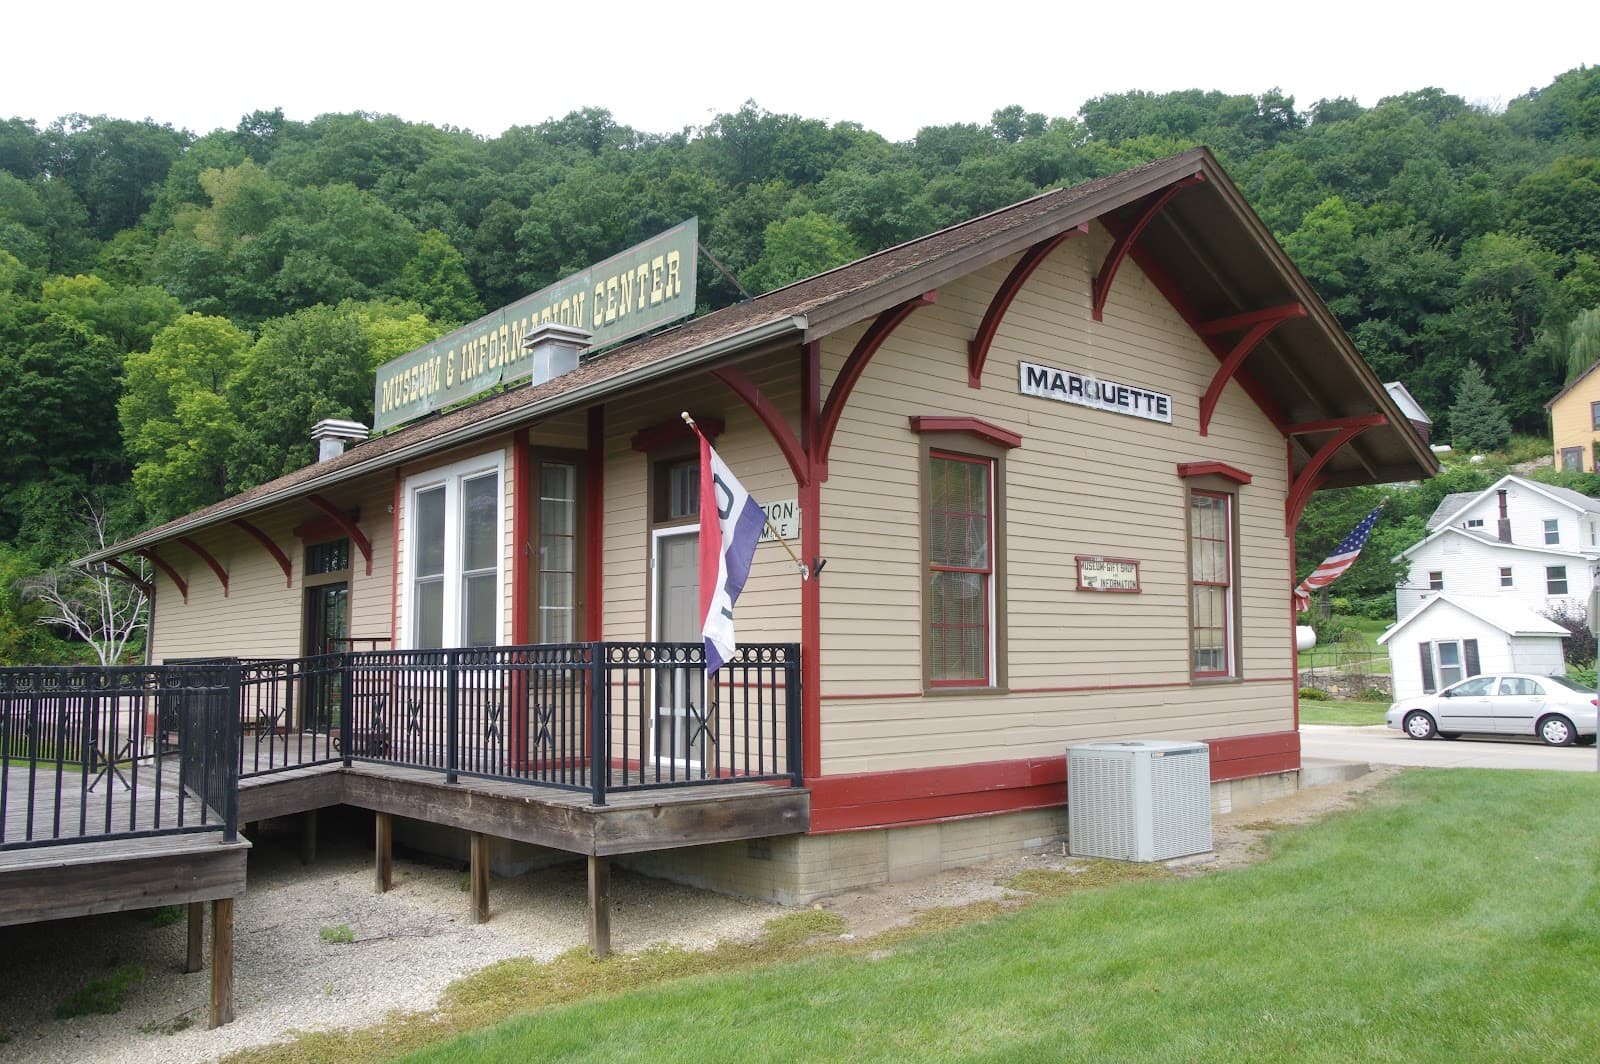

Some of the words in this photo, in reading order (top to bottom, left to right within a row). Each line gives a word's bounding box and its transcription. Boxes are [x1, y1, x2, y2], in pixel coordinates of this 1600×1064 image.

[381, 355, 442, 414] MUSEUM
[446, 350, 455, 388] &
[593, 250, 681, 328] CENTER
[1027, 366, 1168, 415] MARQUETTE
[760, 502, 793, 520] ION
[1100, 578, 1136, 589] INFORMATION
